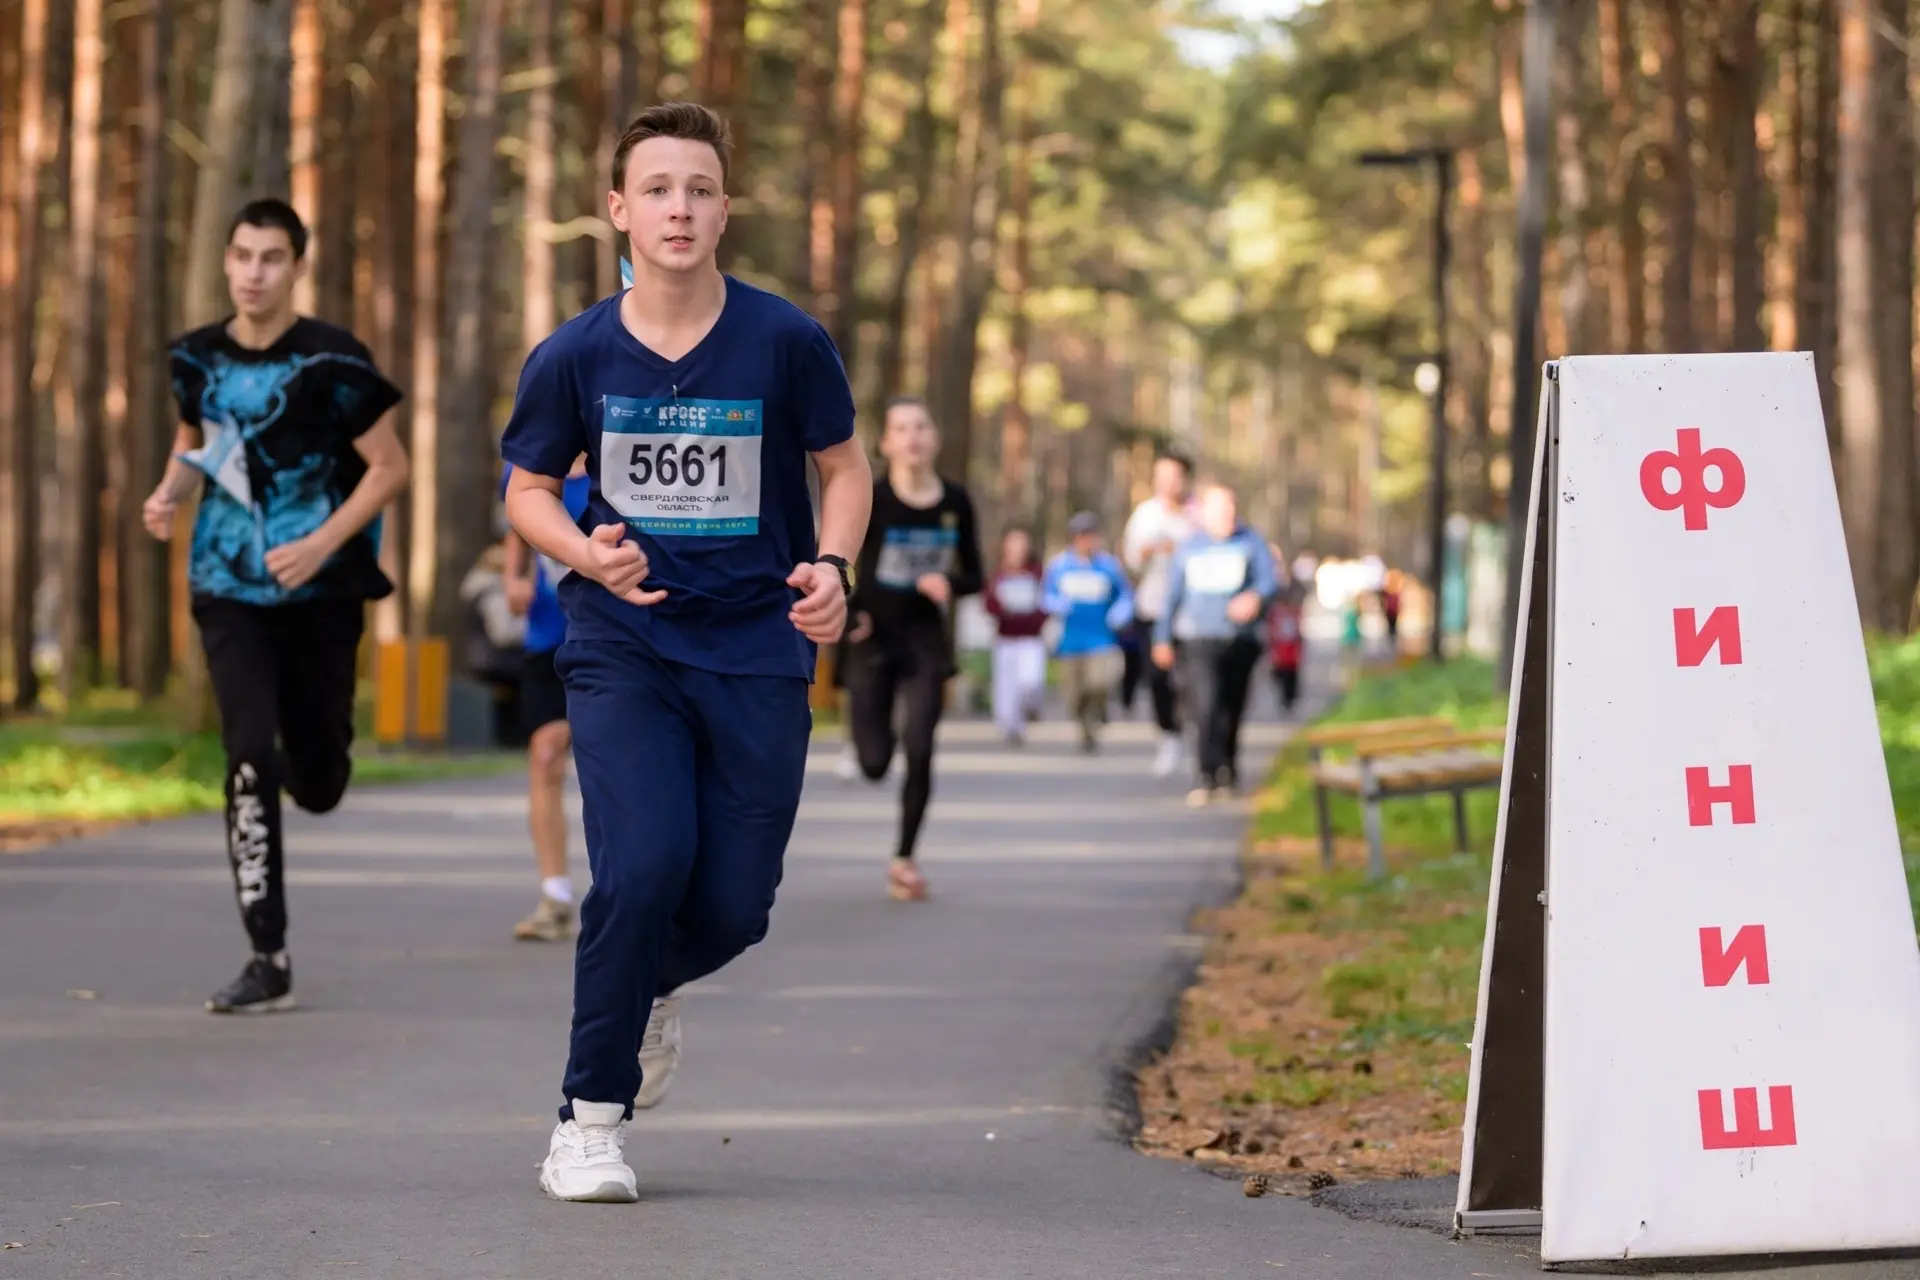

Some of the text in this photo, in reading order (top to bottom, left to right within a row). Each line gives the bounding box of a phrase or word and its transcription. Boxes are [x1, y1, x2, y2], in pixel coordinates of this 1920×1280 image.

[658, 405, 708, 421] КРОСС
[658, 420, 707, 429] НАЦИИ
[628, 443, 727, 487] 5661
[630, 494, 730, 503] СВЕРДЛОВСКАЯ
[656, 504, 703, 512] ОБЛАСТЬ
